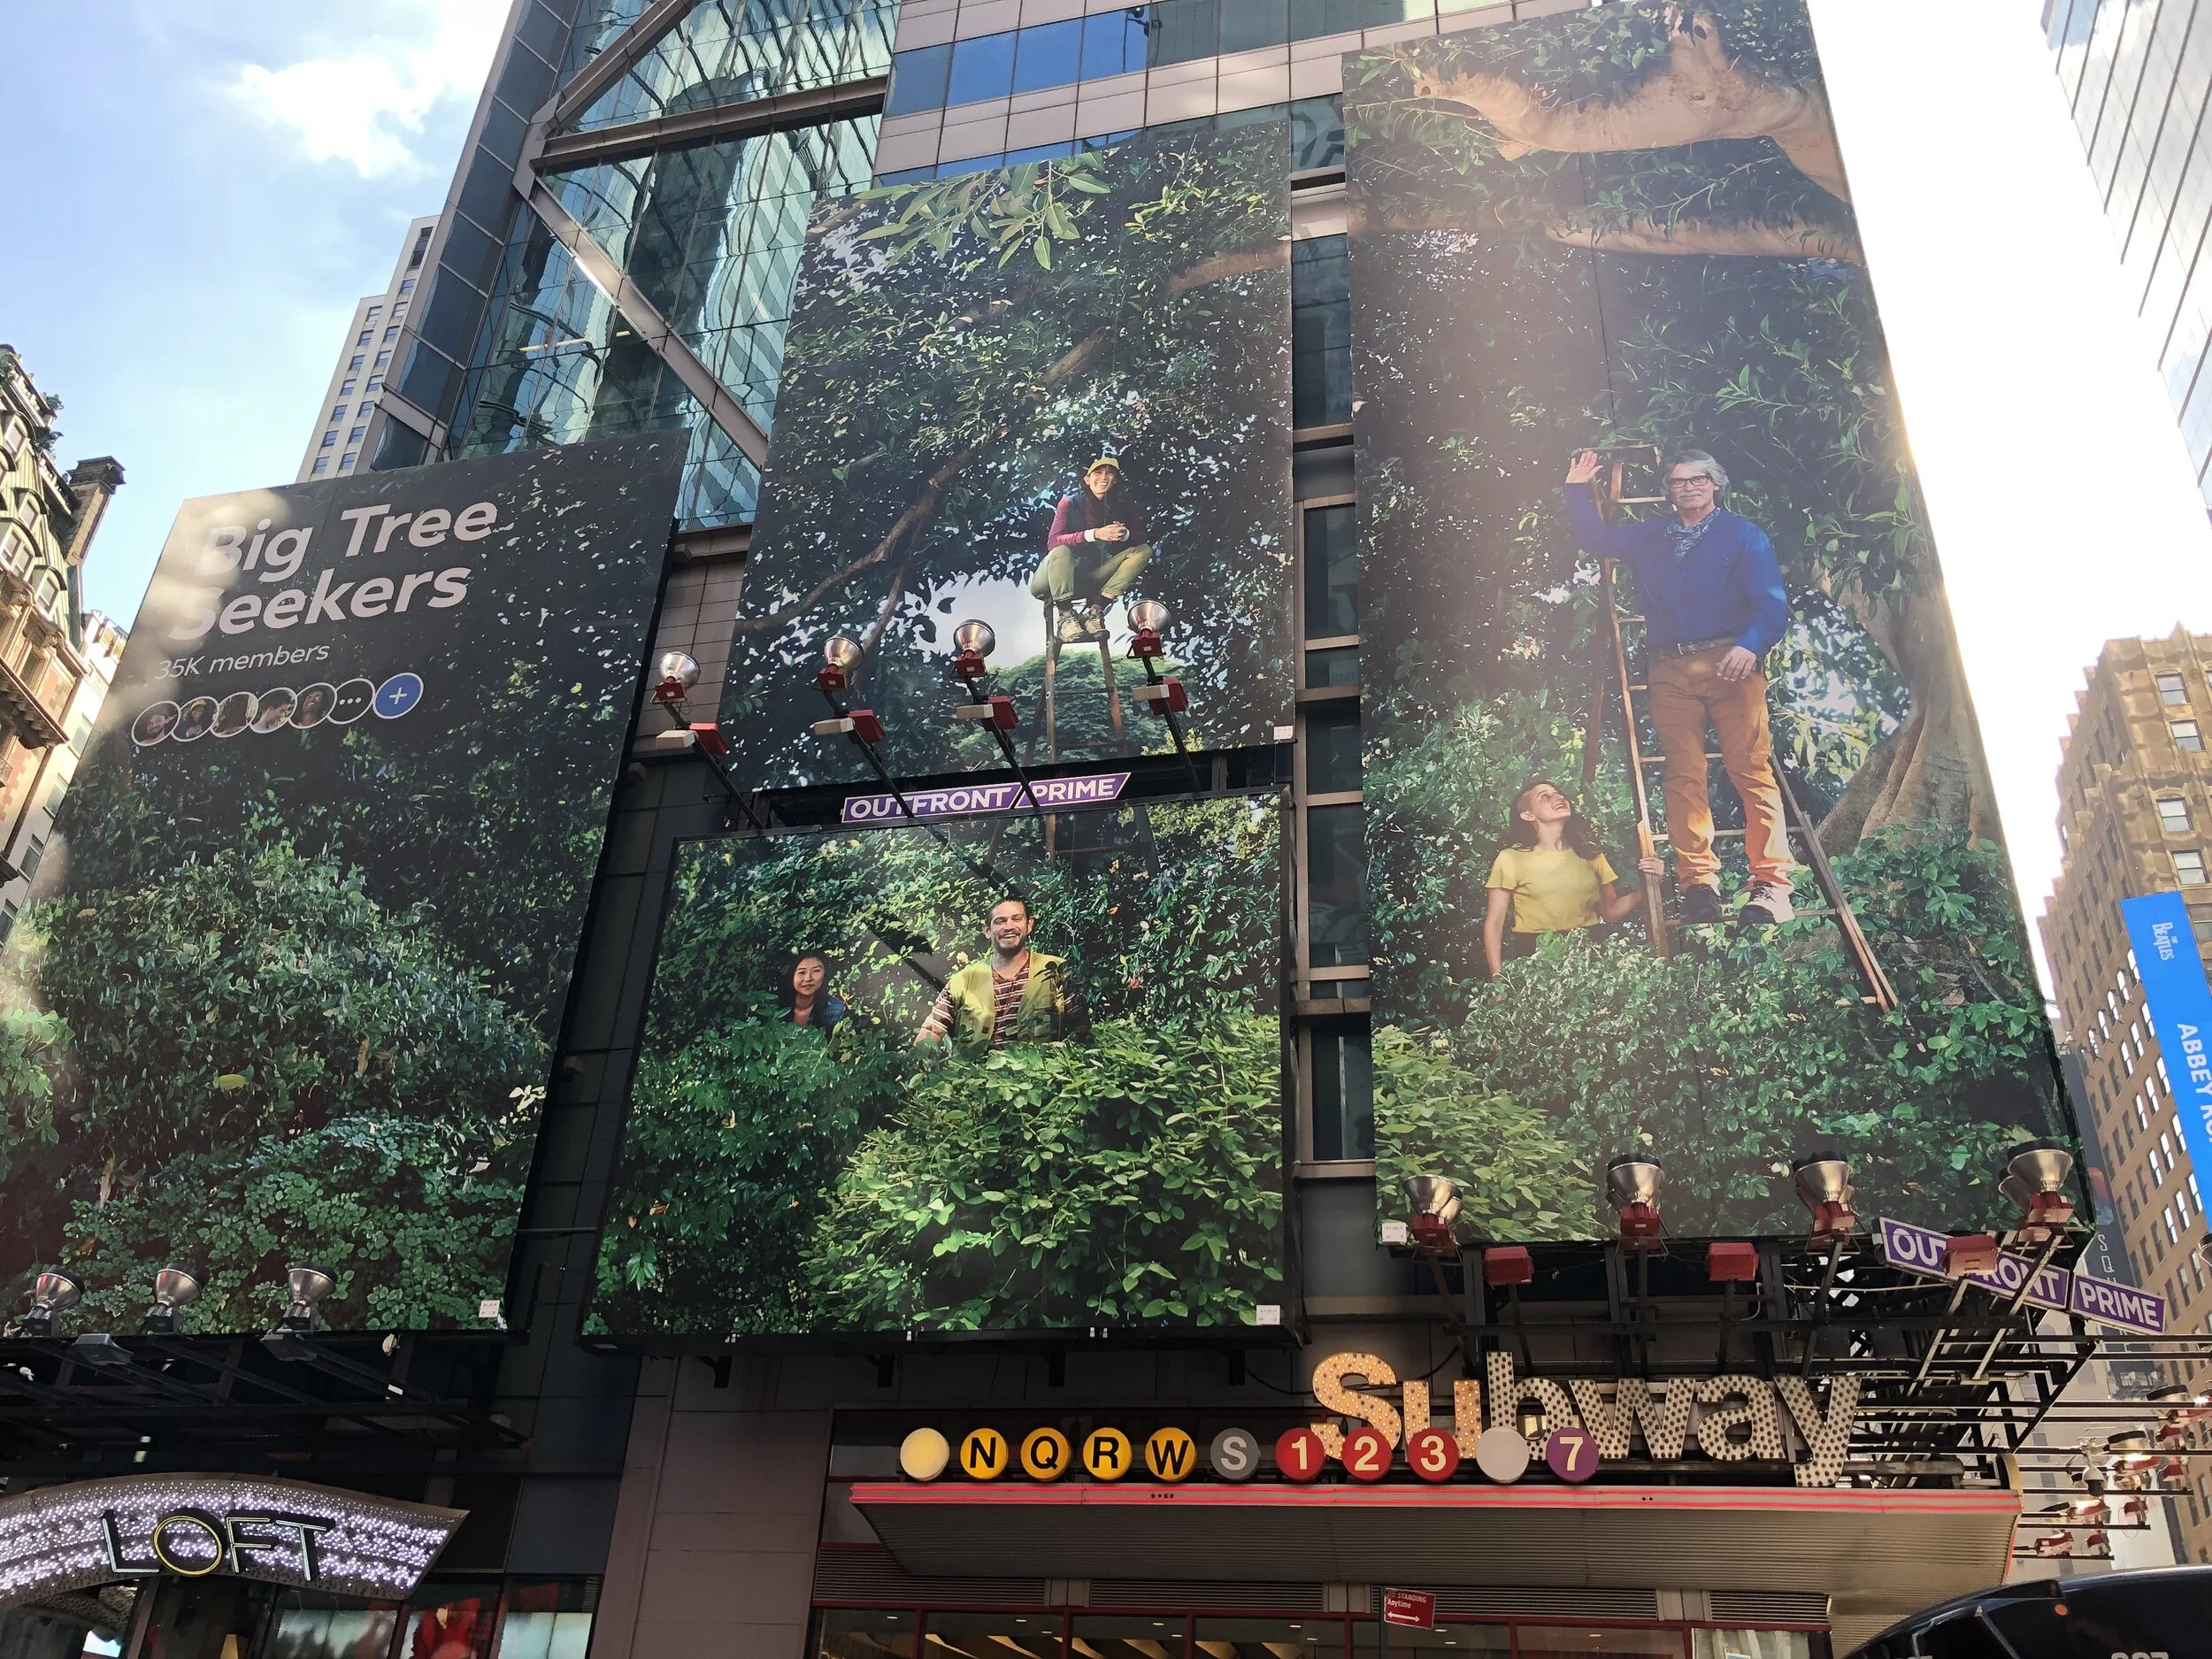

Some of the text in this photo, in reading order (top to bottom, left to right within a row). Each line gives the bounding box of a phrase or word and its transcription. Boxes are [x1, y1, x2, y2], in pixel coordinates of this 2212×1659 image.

[194, 502, 498, 583] Big Tree
[168, 567, 472, 641] Seekers
[154, 643, 330, 680] 35K members
[850, 779, 1116, 818] OUTFRONT PRIME
[2079, 1280, 2160, 1327] PRIME
[1311, 1352, 1861, 1487] Subway
[969, 1436, 1584, 1475] N Q R W S 1 2 3 7
[101, 1507, 334, 1581] LOFT
[1387, 1598, 1412, 1609] Anytime
[1398, 1593, 1426, 1603] STANDING
